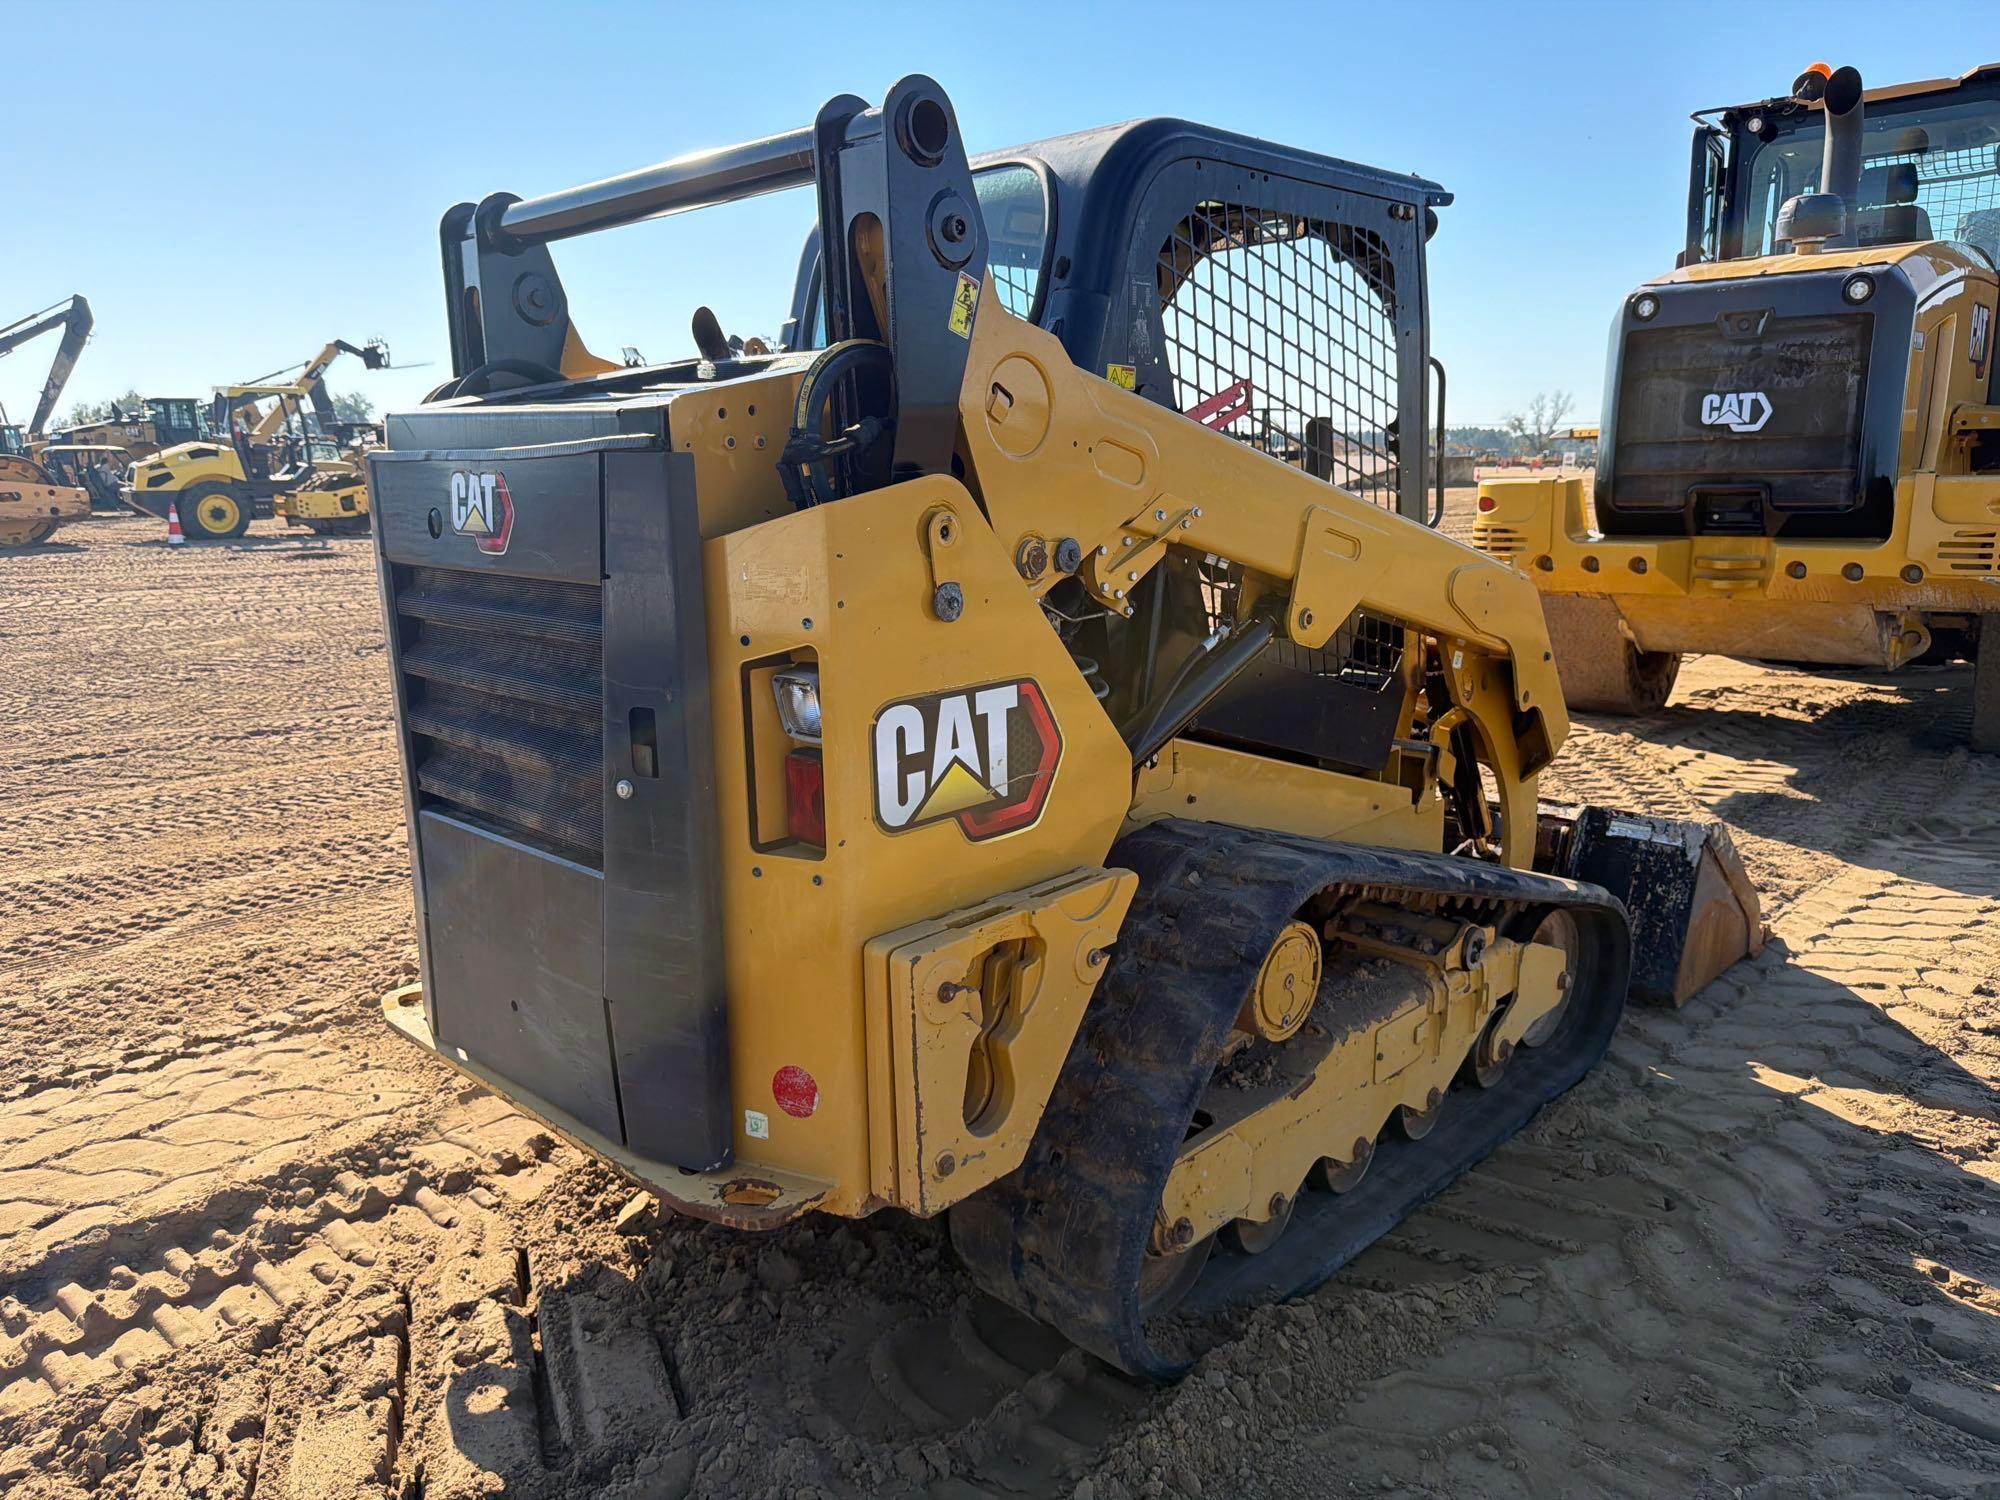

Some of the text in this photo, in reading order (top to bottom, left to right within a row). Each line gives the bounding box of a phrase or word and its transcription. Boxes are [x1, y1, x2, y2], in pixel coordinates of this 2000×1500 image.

[1969, 303, 1990, 361] CAT
[1701, 392, 1757, 425] CAT
[451, 471, 496, 534] CAT
[875, 684, 1019, 828] CAT
